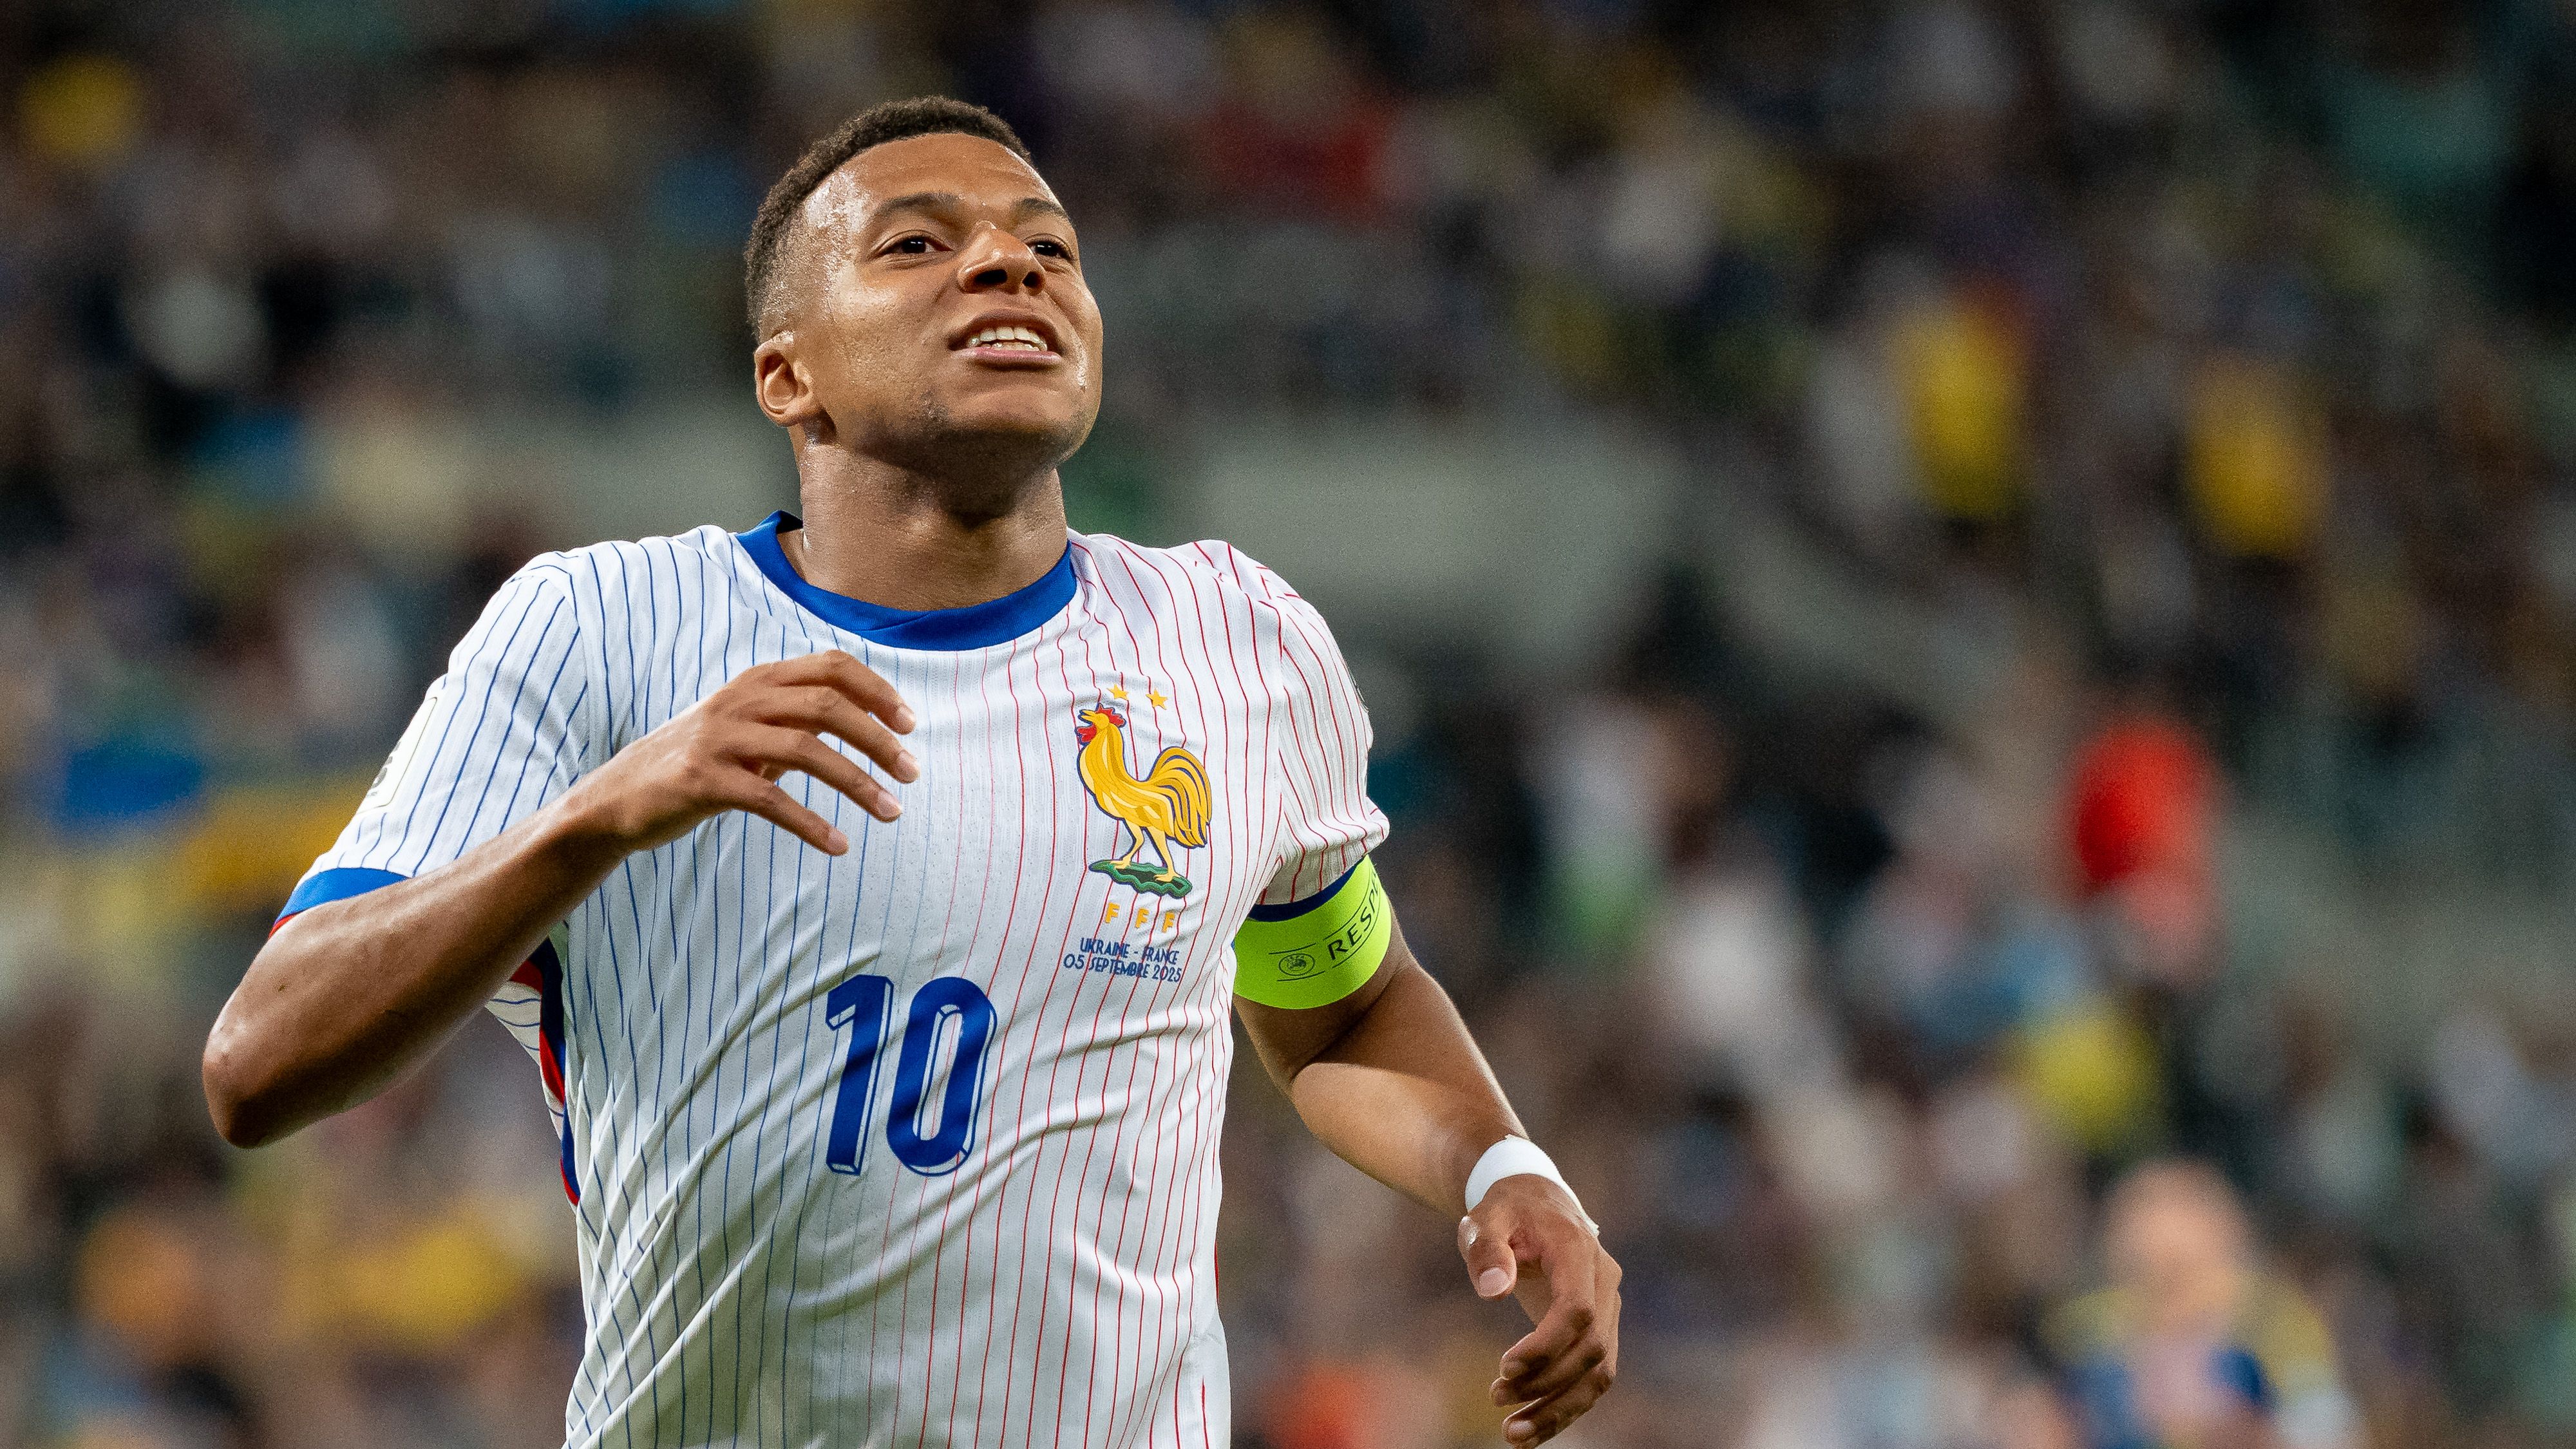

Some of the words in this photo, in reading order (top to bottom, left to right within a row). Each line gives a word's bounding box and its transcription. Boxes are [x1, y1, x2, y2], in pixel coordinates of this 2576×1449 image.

[1080, 938, 1130, 958] UKRAINE
[1142, 946, 1179, 965] FRANCE
[1063, 953, 1084, 969] 05
[1088, 957, 1150, 978] SEPTEMBRE
[1151, 965, 1182, 982] 2025
[826, 974, 998, 1177] 10
